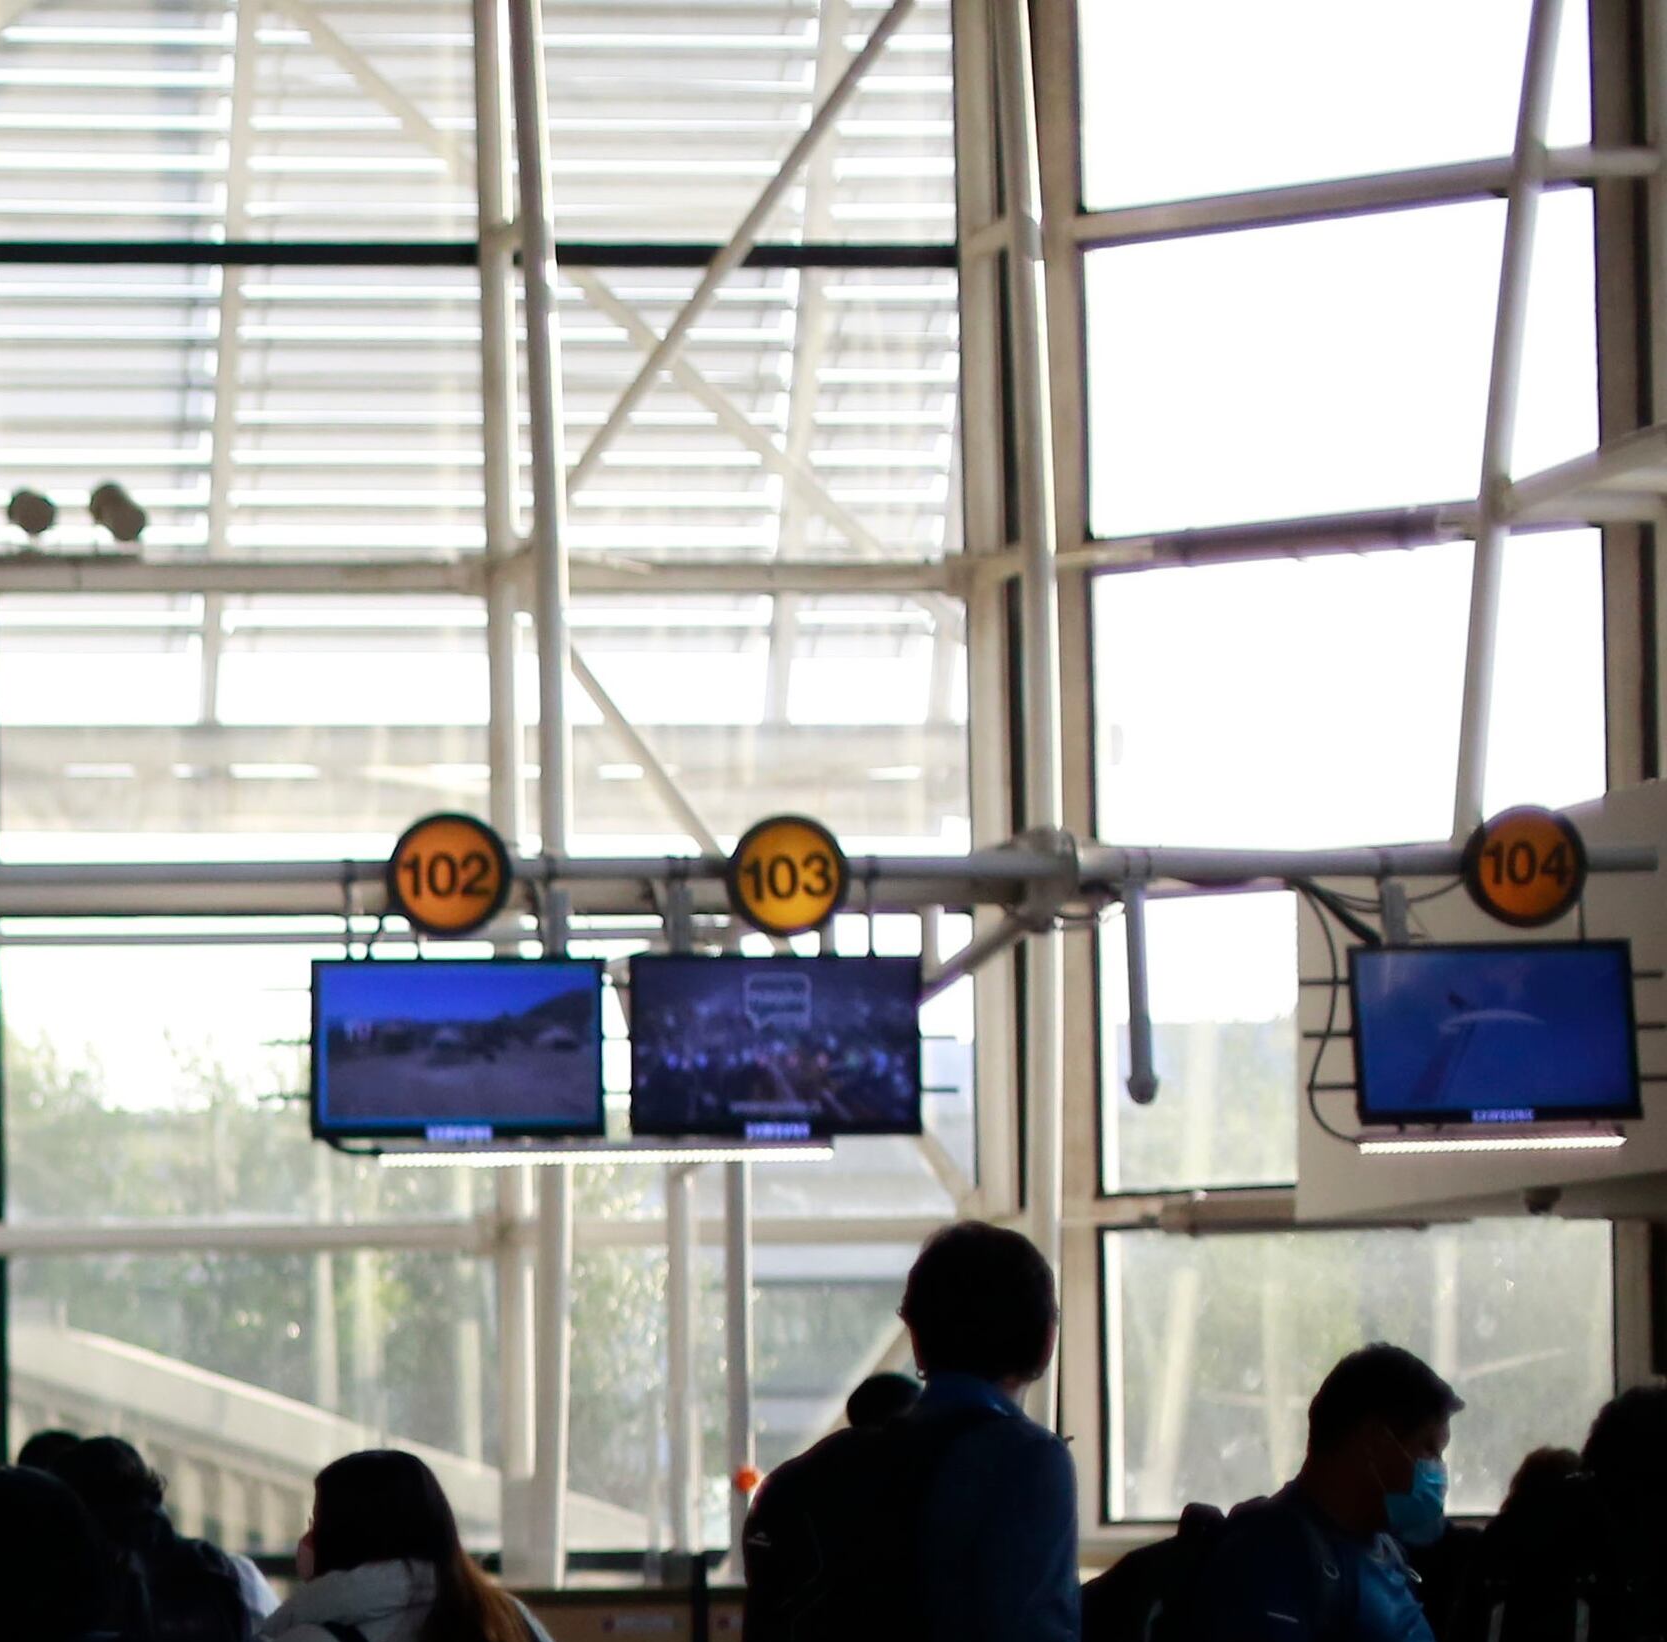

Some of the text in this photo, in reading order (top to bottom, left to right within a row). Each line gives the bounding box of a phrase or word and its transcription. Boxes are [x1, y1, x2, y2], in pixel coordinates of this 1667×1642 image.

[402, 851, 493, 900] 102
[742, 851, 834, 903] 103
[1483, 840, 1572, 886] 104
